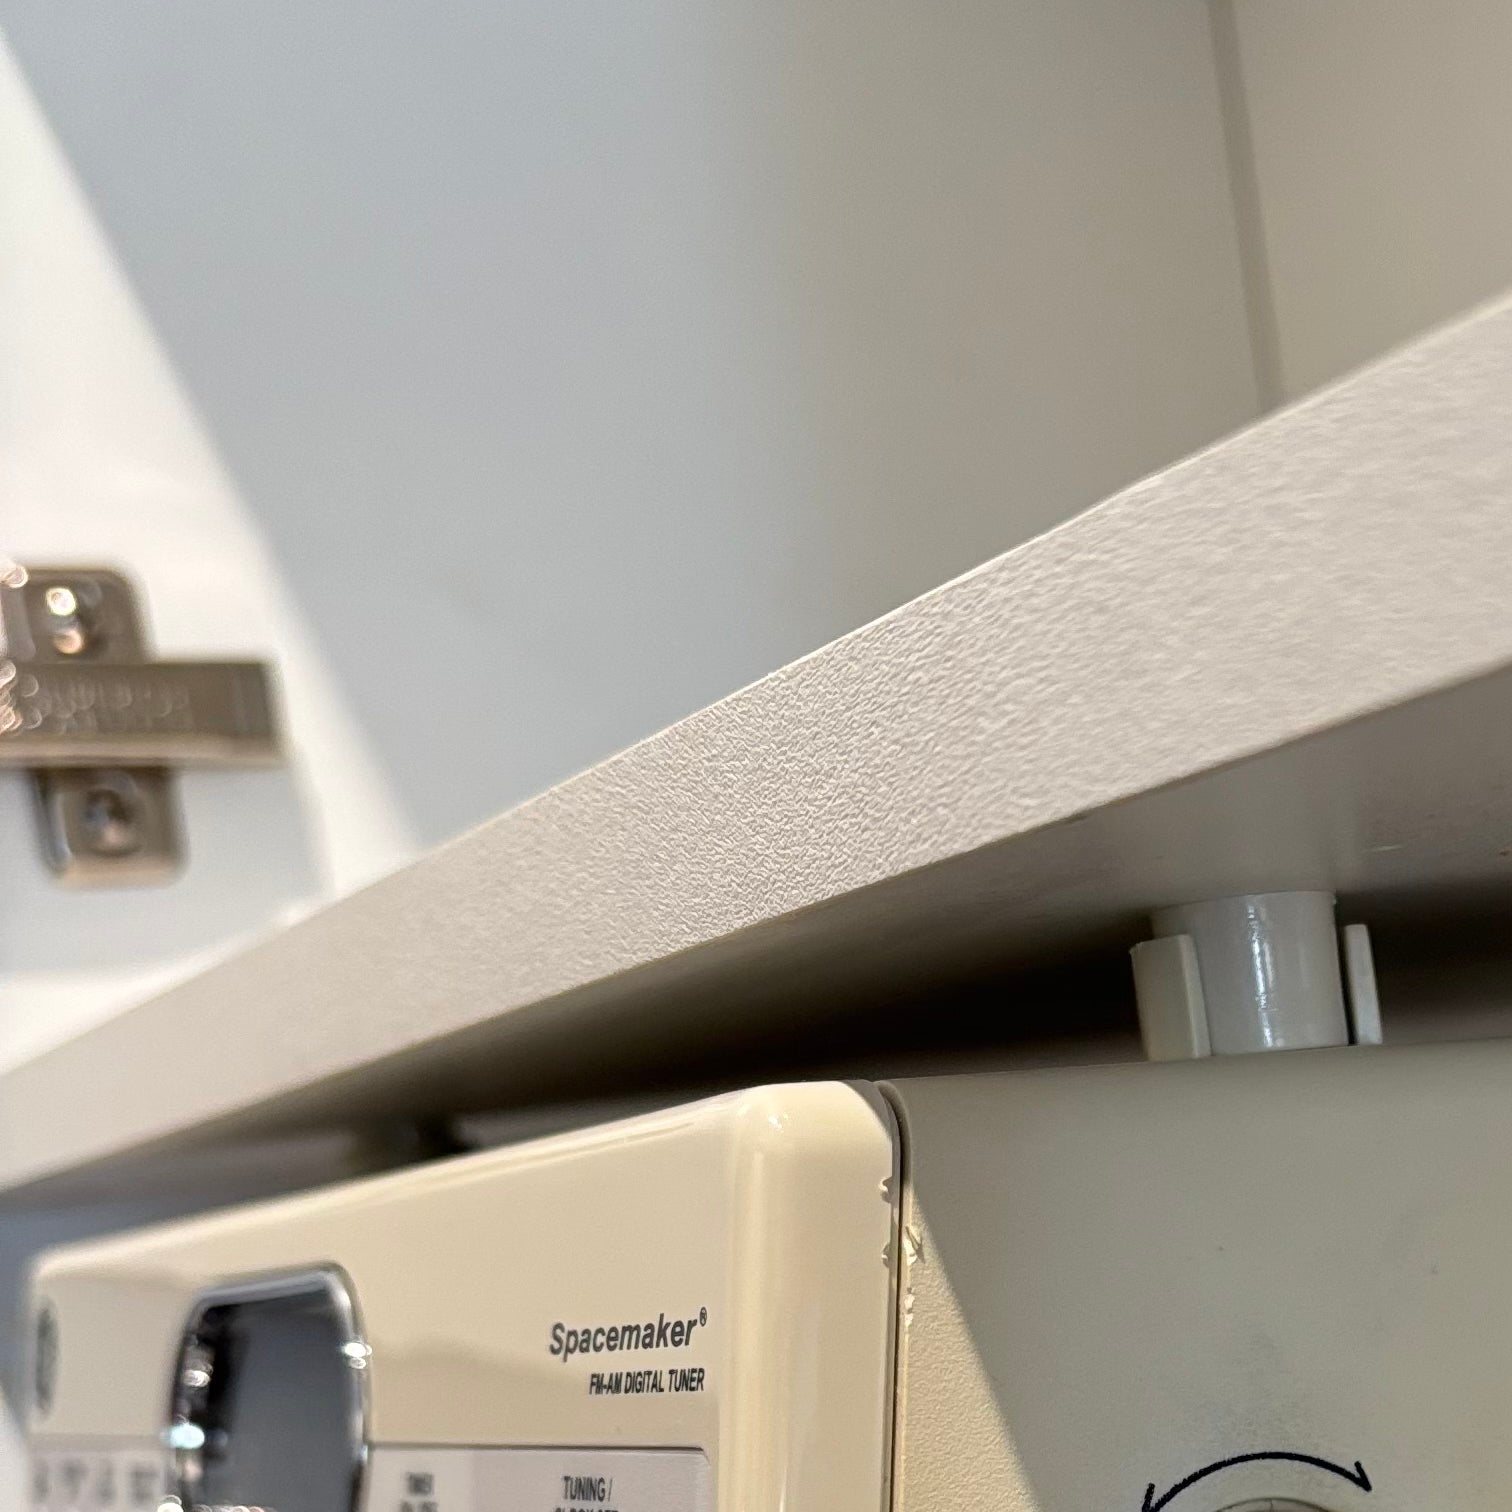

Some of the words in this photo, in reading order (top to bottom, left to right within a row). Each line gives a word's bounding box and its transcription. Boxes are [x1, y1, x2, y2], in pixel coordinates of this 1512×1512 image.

[589, 1372, 623, 1394] FM-AM
[624, 1370, 664, 1394] DIGITAL
[669, 1368, 705, 1392] TUNER
